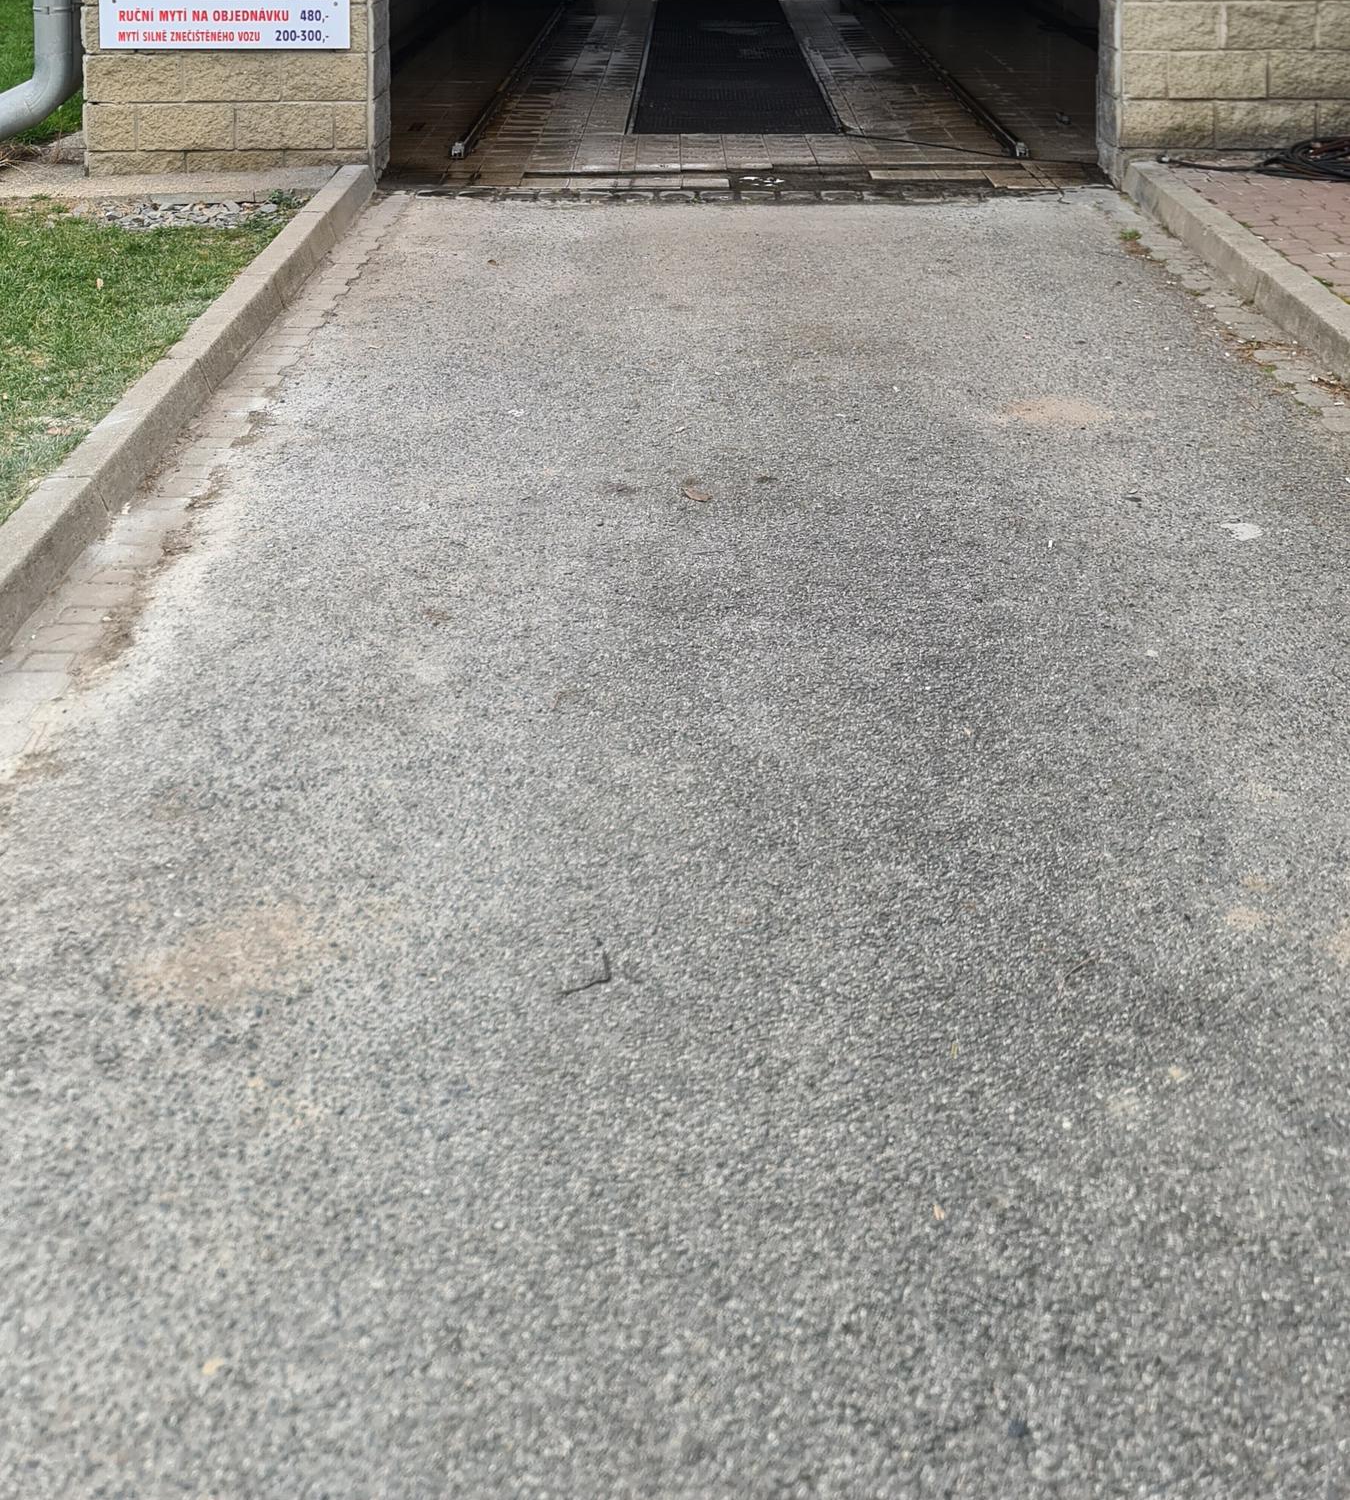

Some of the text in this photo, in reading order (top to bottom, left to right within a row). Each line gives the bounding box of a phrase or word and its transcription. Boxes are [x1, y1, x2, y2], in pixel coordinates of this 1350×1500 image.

[118, 7, 329, 23] RUČNÍ MYTÍ NA OBJEDNÁVKU 480,-
[118, 30, 139, 42] MYTÍ
[170, 30, 234, 42] ZNEČIŠTĚNÉHO
[237, 31, 260, 41] VOZU
[275, 30, 329, 43] 200-300,-
